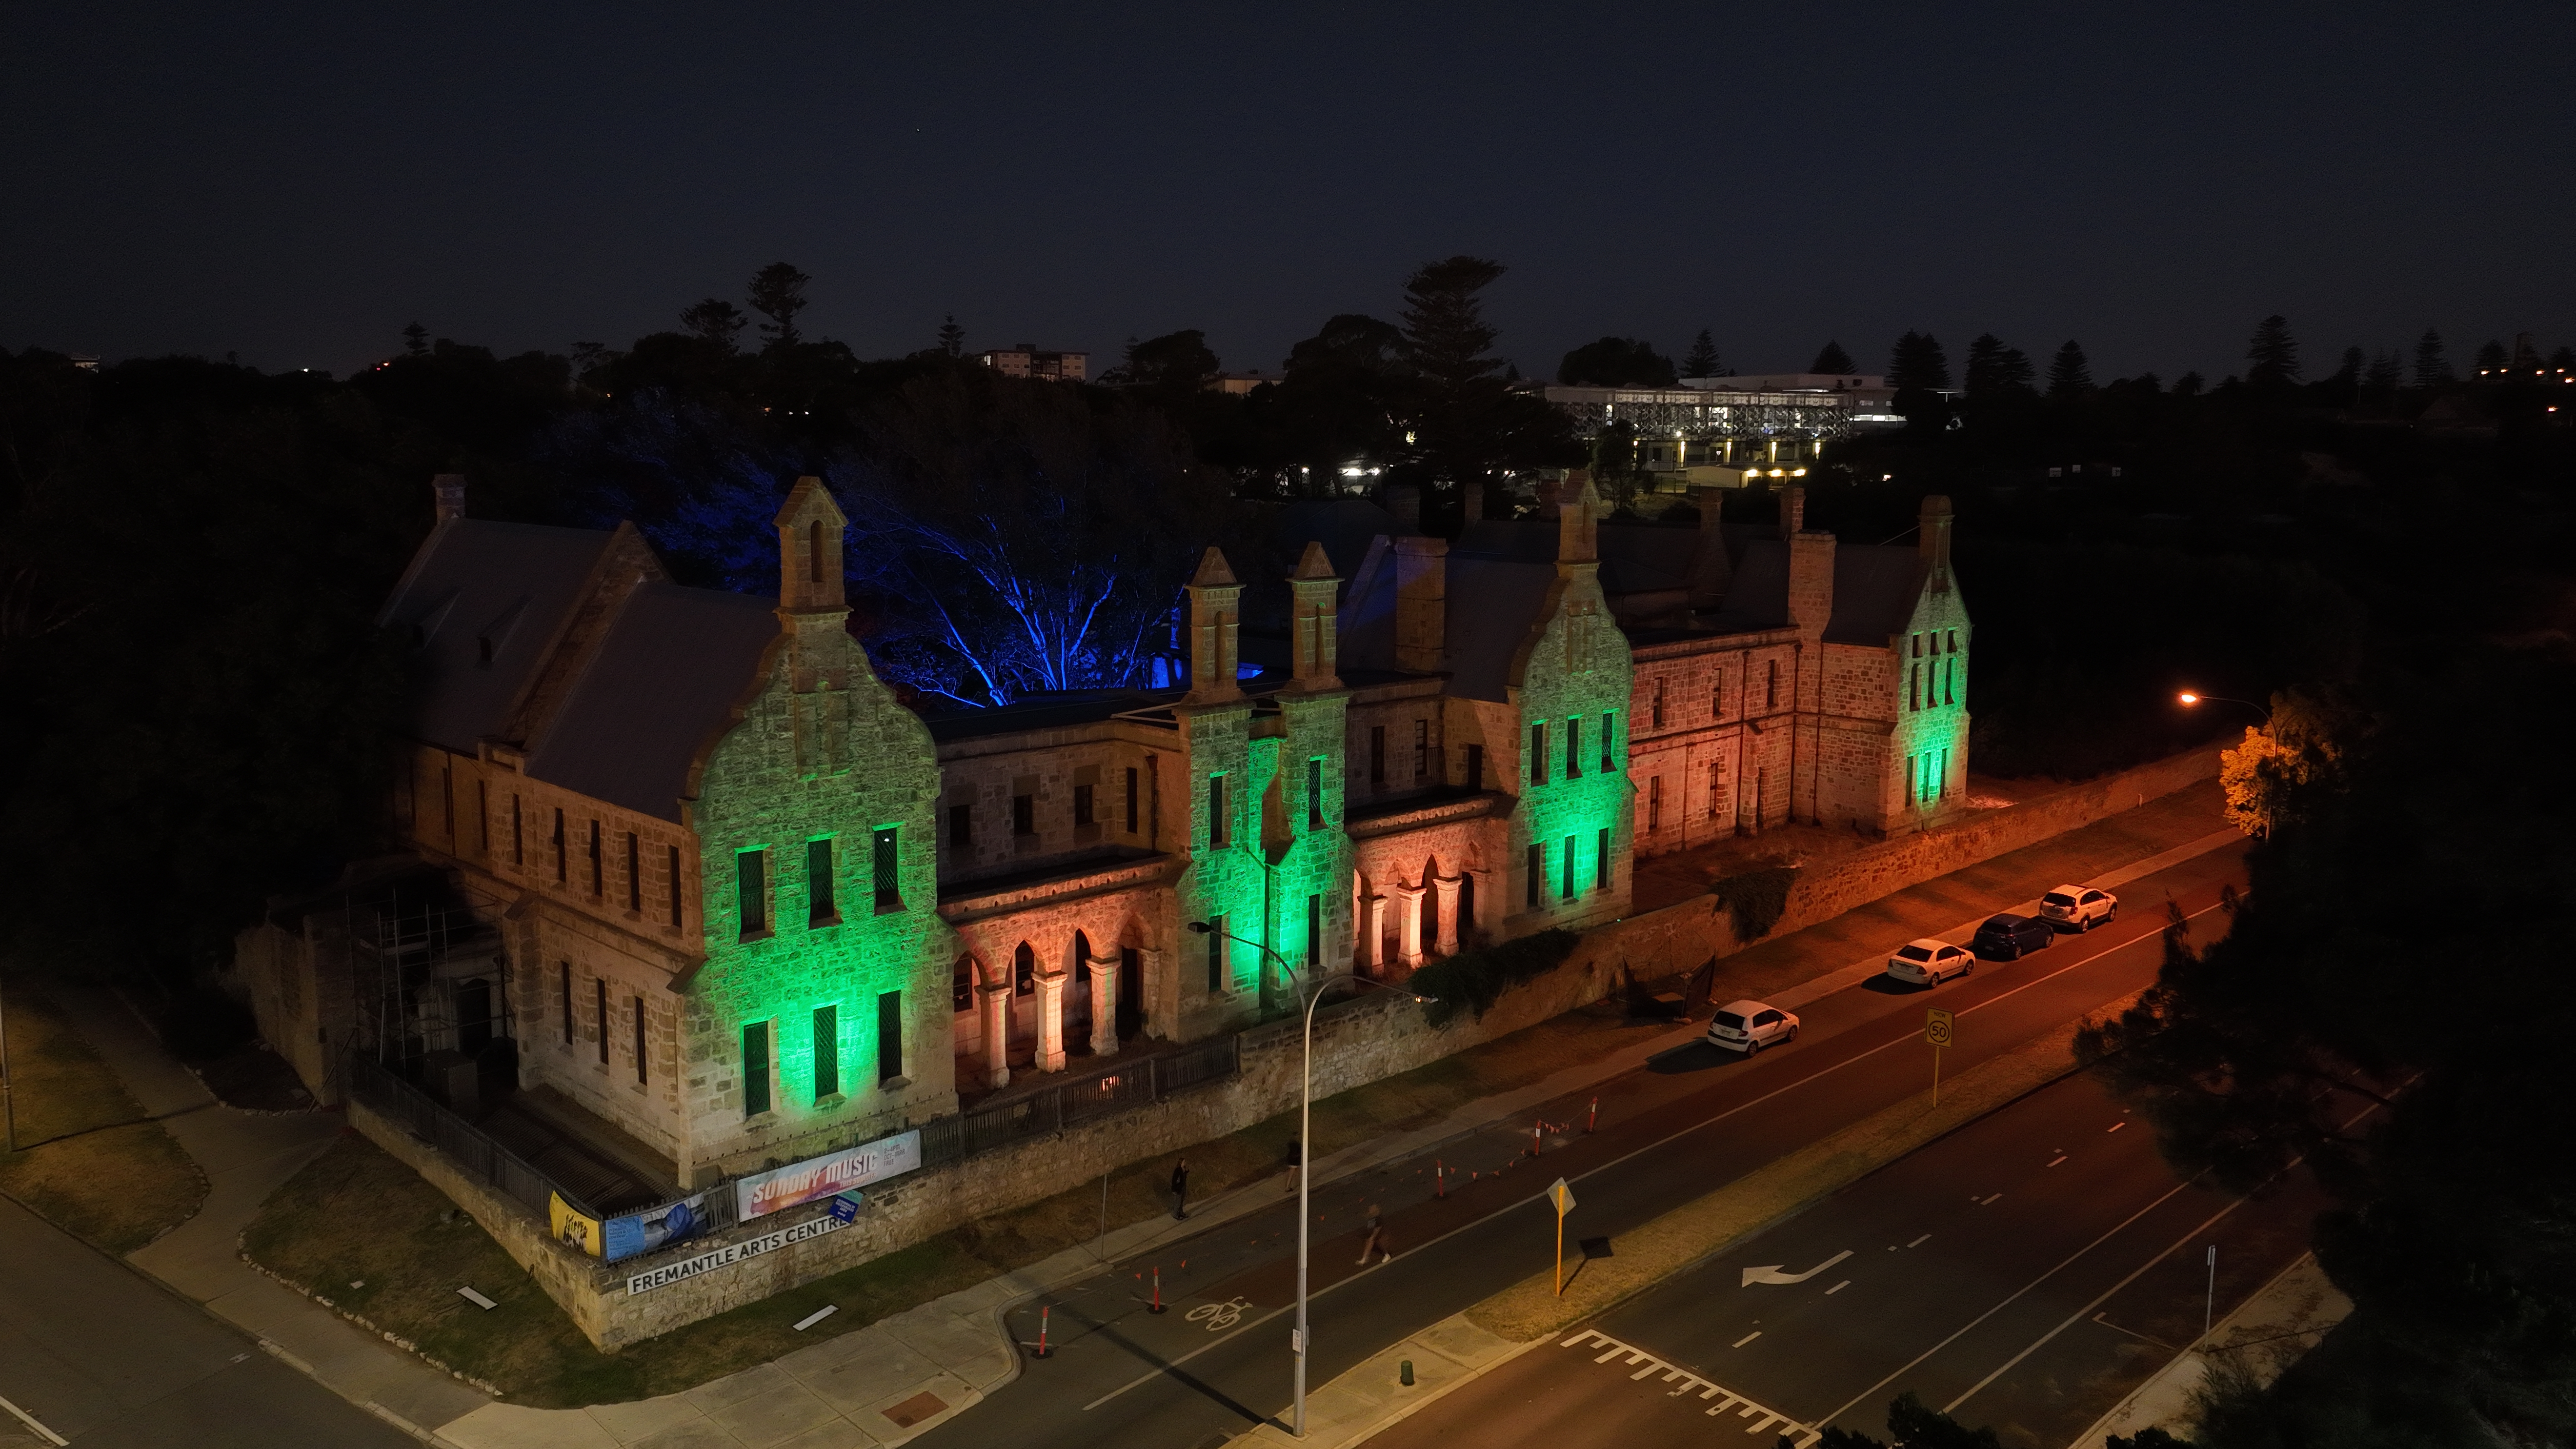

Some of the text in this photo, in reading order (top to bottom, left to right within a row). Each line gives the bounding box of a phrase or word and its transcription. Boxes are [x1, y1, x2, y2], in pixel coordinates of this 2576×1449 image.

[1932, 1026, 1946, 1037] 50
[884, 1158, 894, 1167] FREE
[753, 1152, 878, 1204] SUNDAY MUSIC
[840, 1179, 852, 1188] THIS
[633, 1249, 734, 1293] FREMANTLE
[739, 1234, 780, 1259] ARTS
